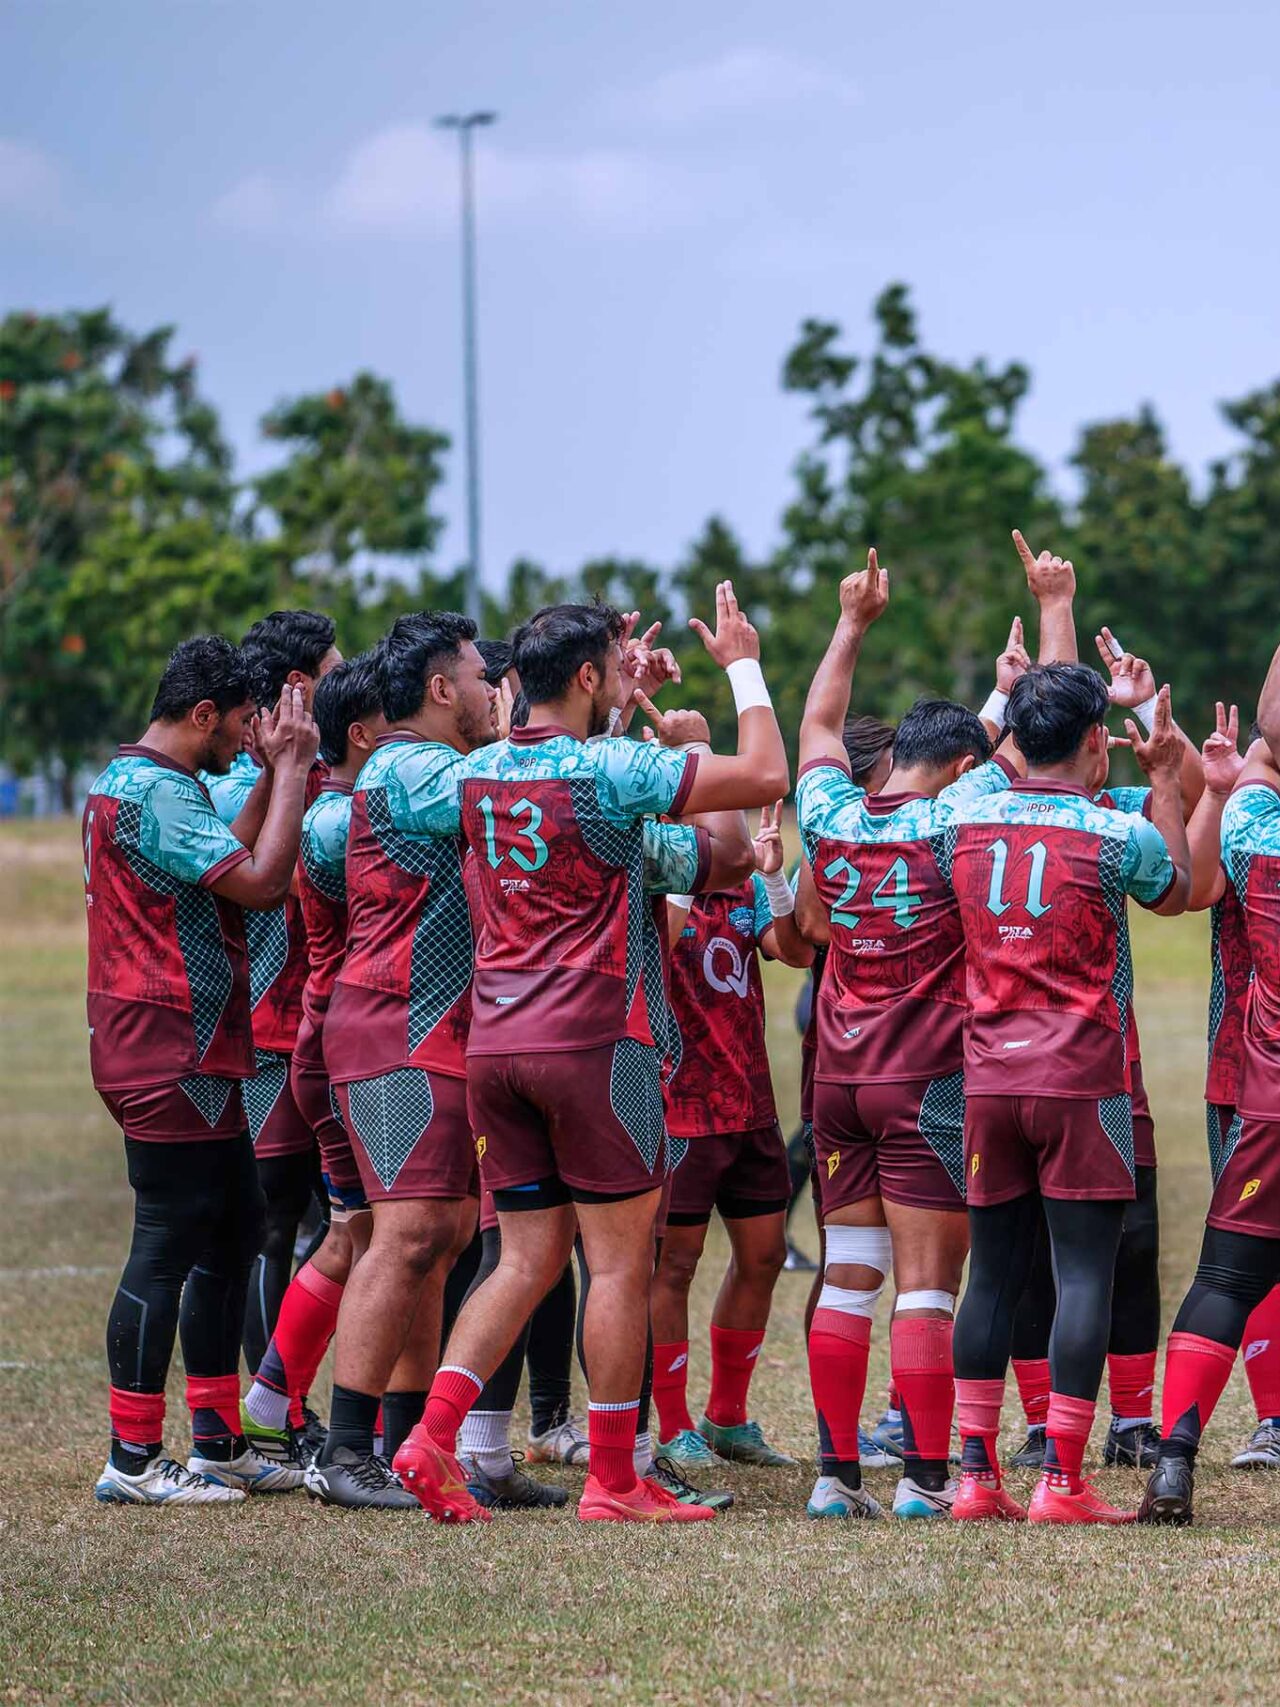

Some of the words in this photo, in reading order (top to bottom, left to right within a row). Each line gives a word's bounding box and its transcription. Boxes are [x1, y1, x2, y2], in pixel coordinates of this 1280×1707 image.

[1026, 803, 1055, 813] iPDP
[475, 794, 549, 872] 13
[500, 879, 530, 888] PITA
[986, 838, 1053, 919] 11
[823, 855, 923, 930] 24
[998, 925, 1033, 936] PITA
[851, 939, 886, 948] PITA
